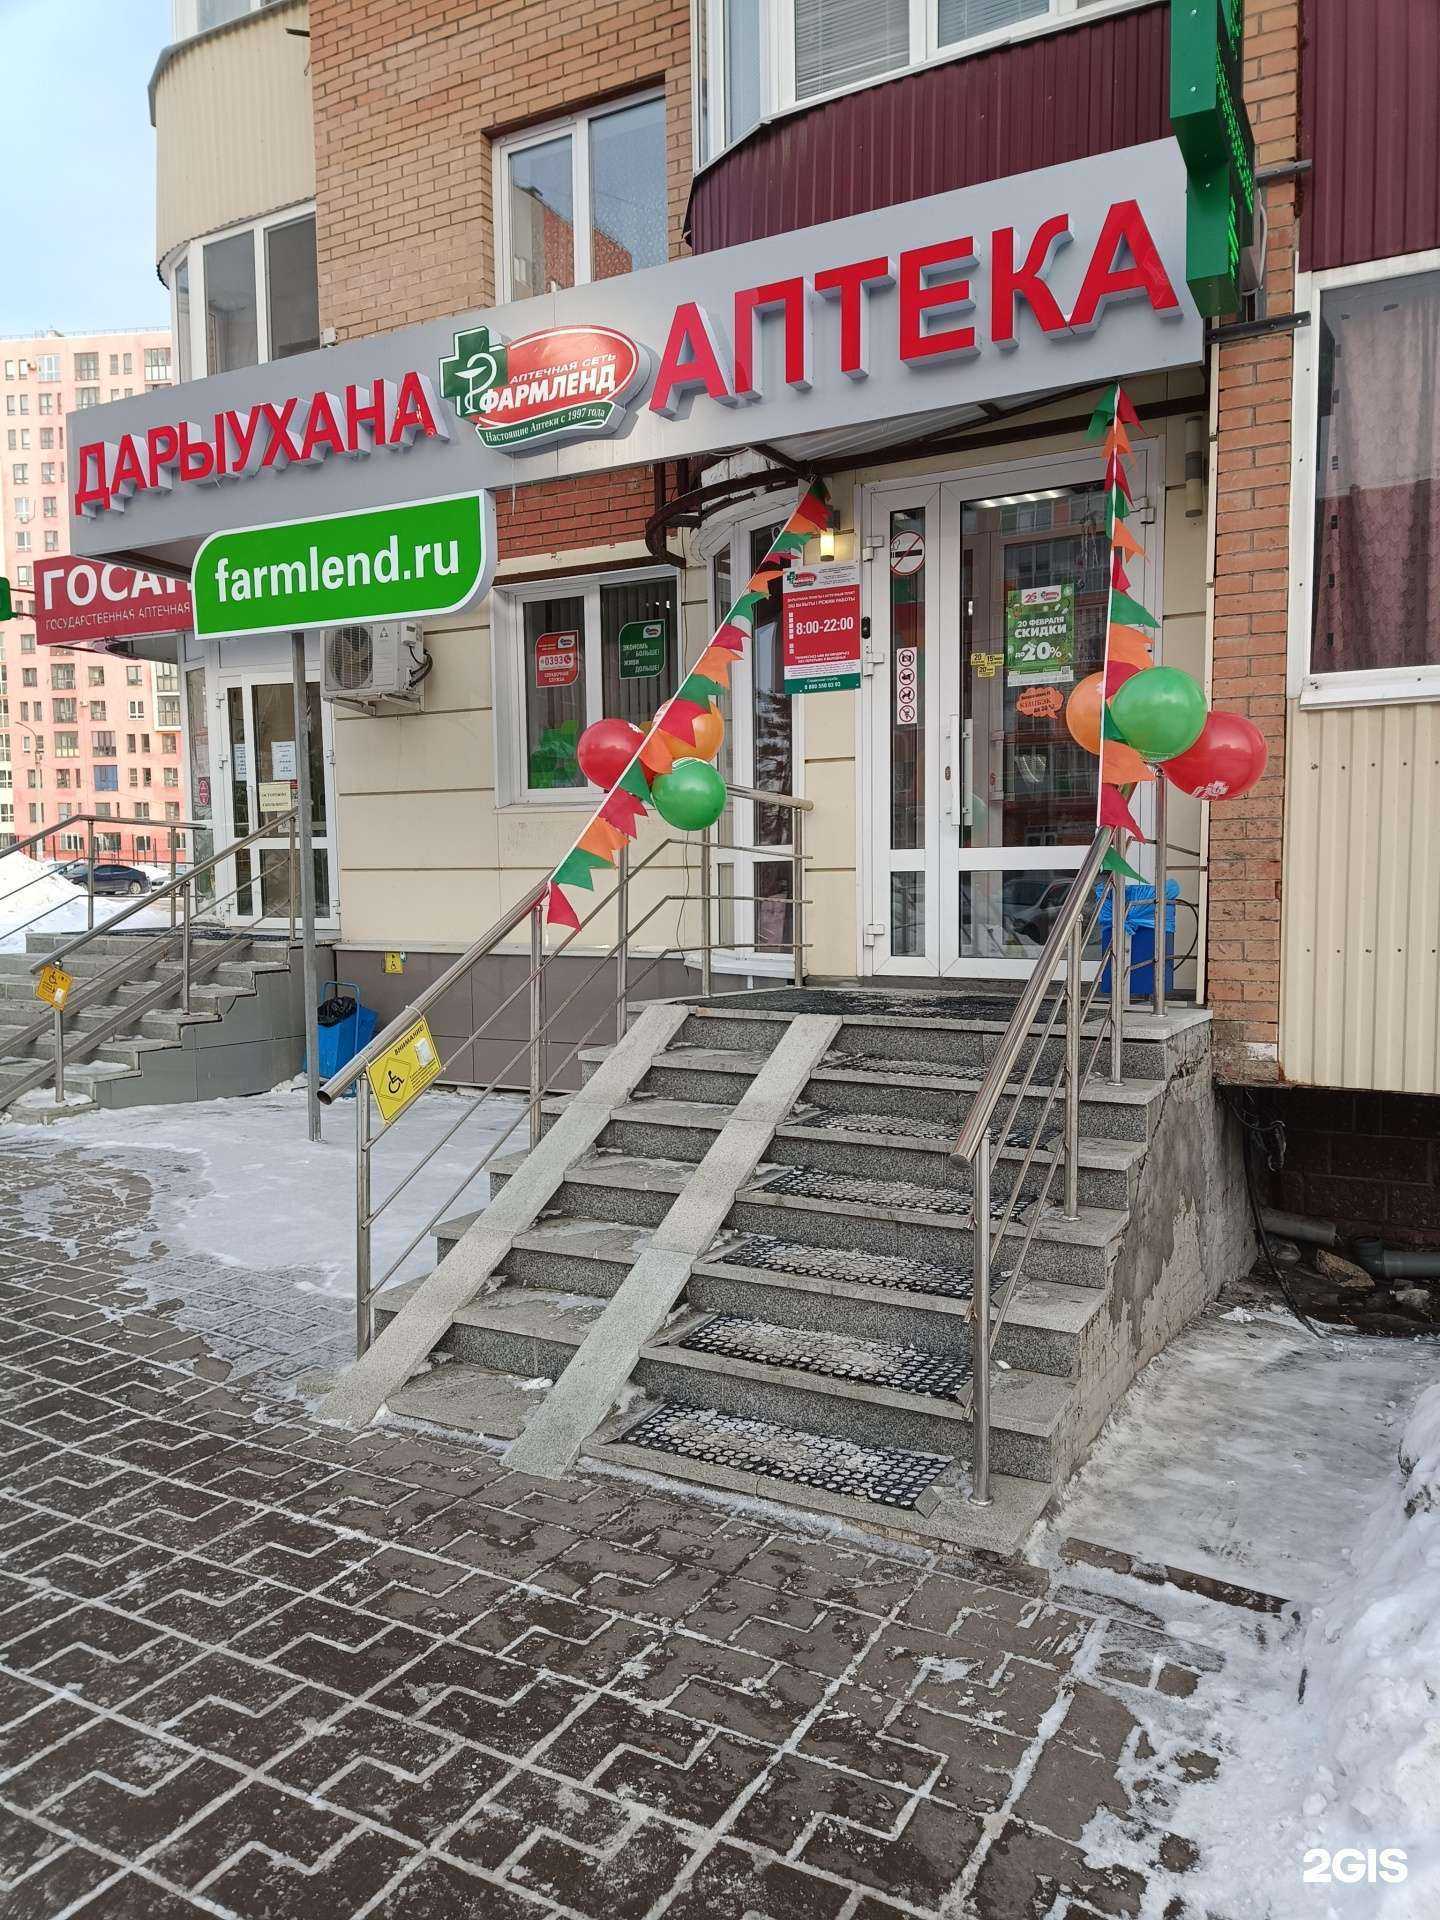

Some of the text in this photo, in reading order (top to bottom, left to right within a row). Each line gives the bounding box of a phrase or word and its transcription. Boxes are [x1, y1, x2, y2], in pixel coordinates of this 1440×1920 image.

[649, 199, 1182, 412] АПТЕКА
[510, 353, 617, 384] АПТЕЧНАЯ СЕТЬ
[479, 364, 616, 413] ФАРМЛЕНД
[485, 425, 529, 443] Настоящие
[530, 417, 560, 435] Аптеки
[568, 407, 586, 421] 1997
[587, 407, 606, 420] года
[75, 371, 439, 516] ДАРЫУХАНА
[214, 534, 460, 603] farmlend.ru
[46, 601, 191, 630] ГОСУДАРСТВЕННАЯ АПТЕЧНАЯ
[796, 616, 854, 635] 8:00-22:00
[1015, 624, 1067, 638] СКИДКИ
[1018, 616, 1064, 628] 20 ФЕВРАЛЯ
[1022, 642, 1062, 661] 20%
